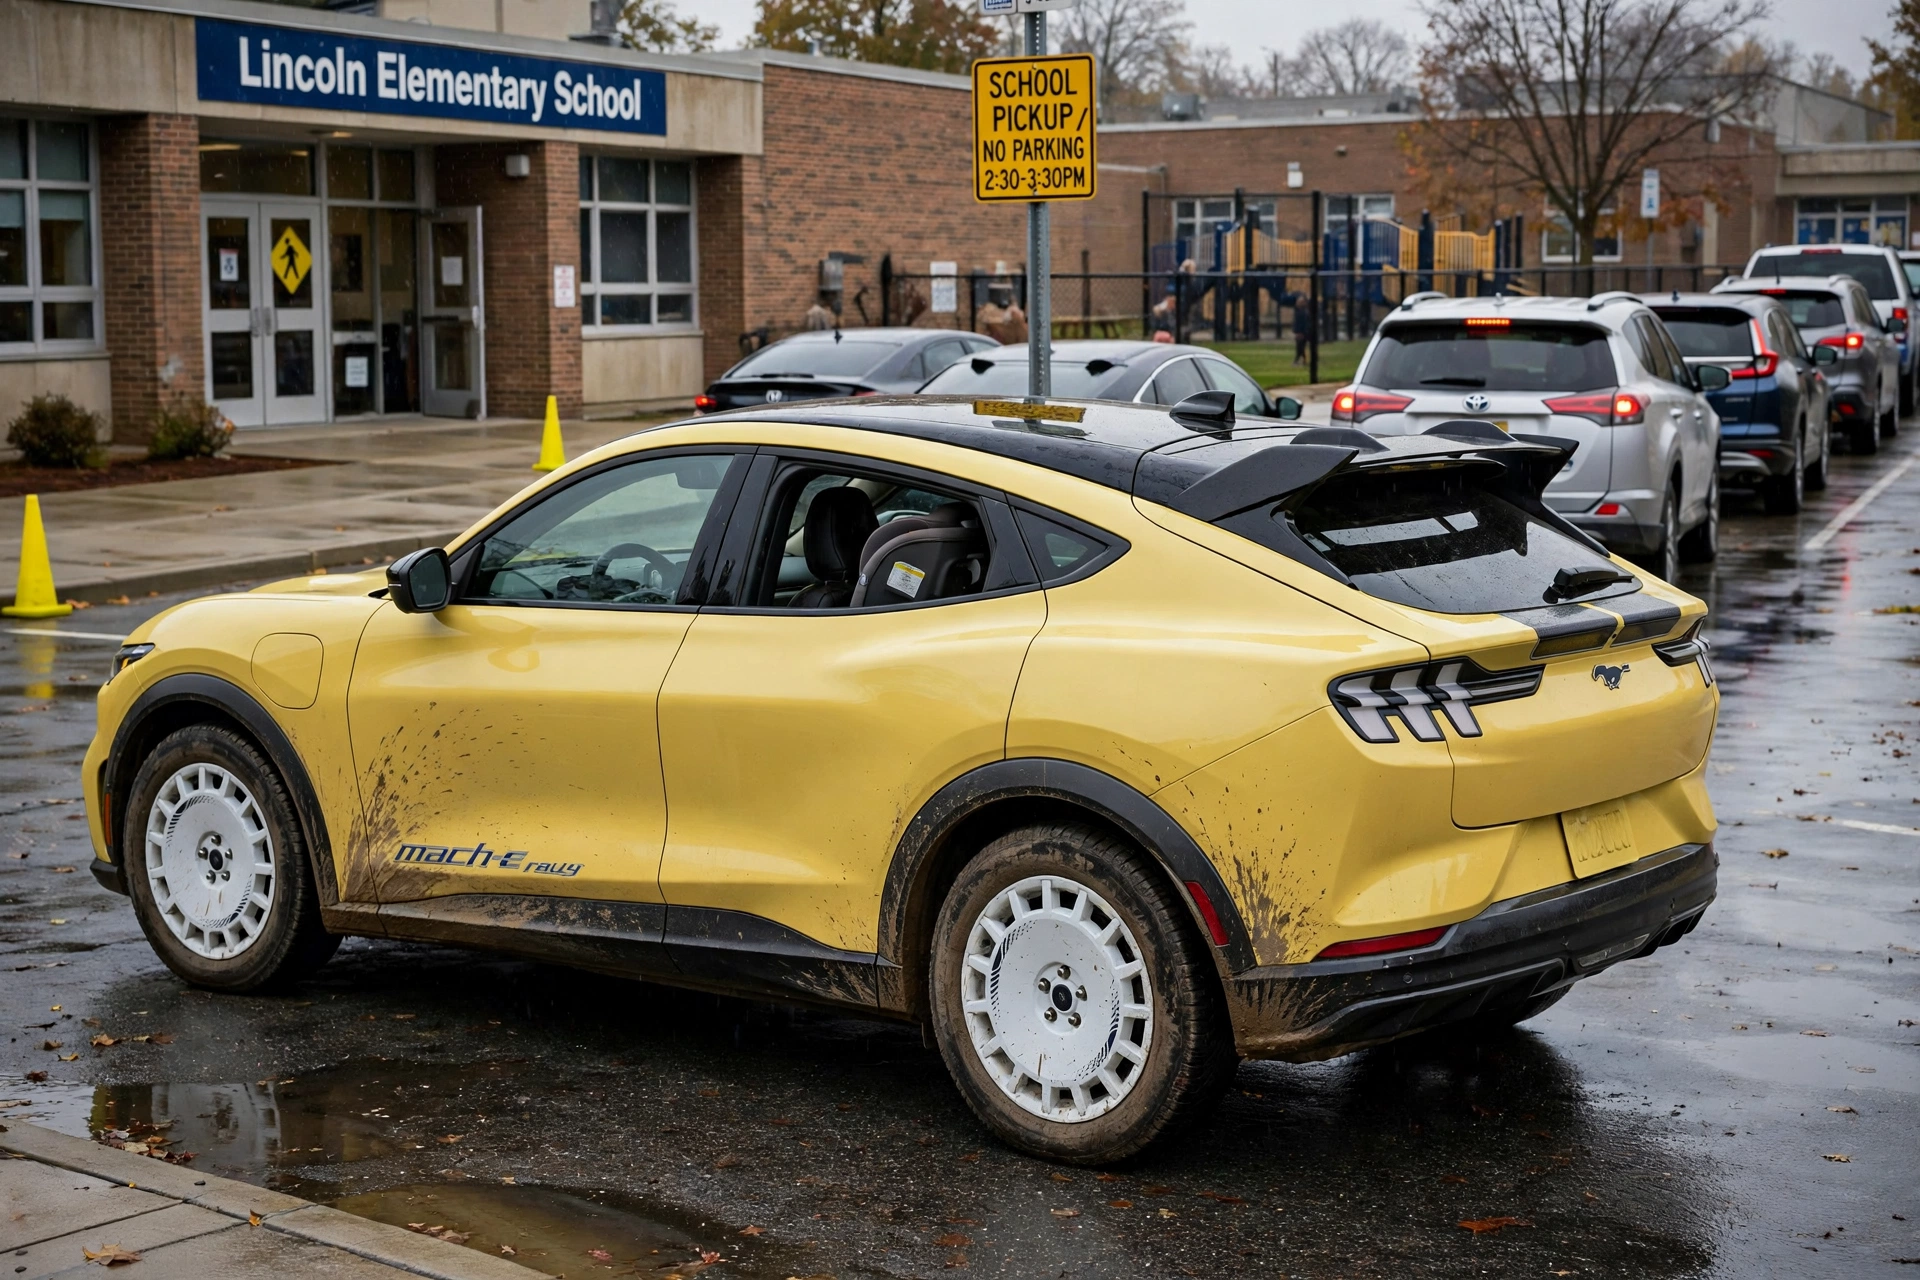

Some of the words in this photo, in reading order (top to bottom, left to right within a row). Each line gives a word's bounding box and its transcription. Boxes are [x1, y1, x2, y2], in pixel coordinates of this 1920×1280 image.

[239, 36, 367, 97] Lincoln
[377, 50, 548, 123] Elementary
[553, 69, 642, 121] School
[989, 68, 1078, 98] SCHOOL
[983, 138, 1006, 163] NO
[1013, 136, 1084, 162] PARKING
[984, 166, 1085, 191] 2:30-3:30PM
